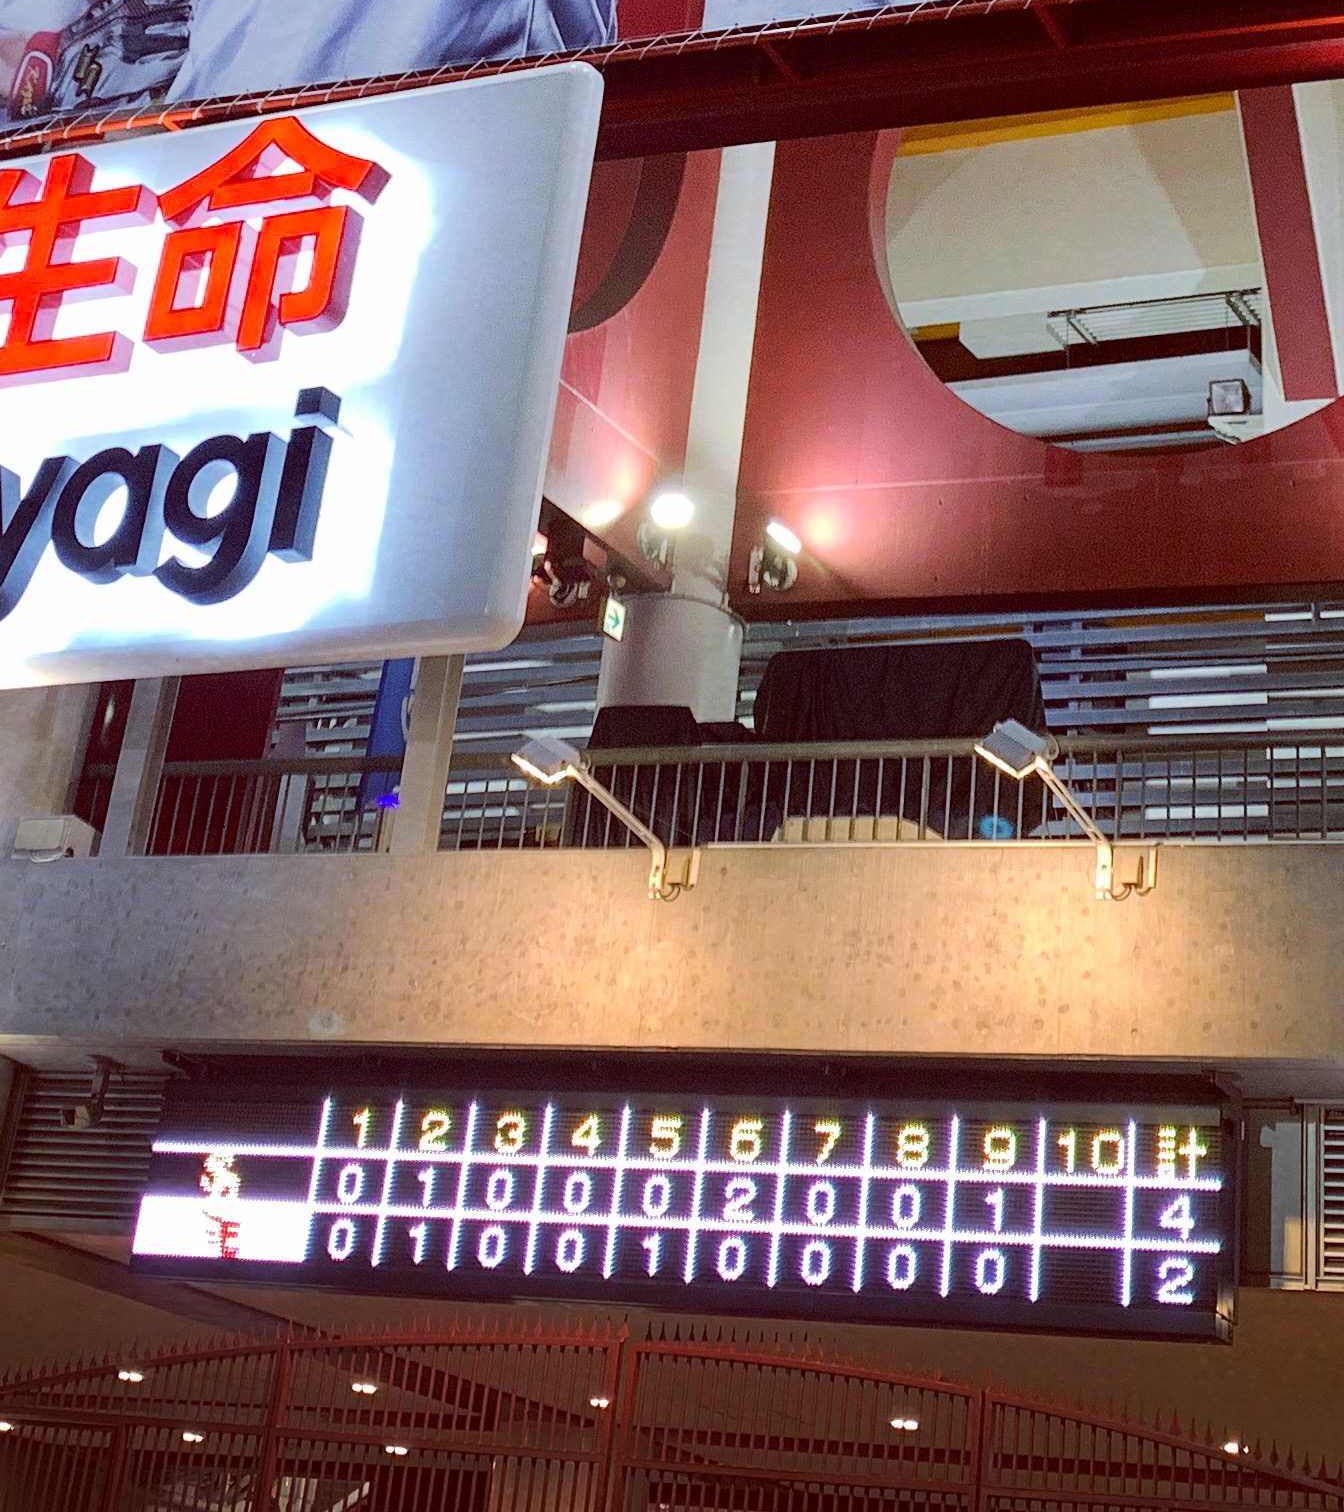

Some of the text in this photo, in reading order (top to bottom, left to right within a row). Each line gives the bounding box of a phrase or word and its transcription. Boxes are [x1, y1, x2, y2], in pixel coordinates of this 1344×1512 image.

[353, 1107, 372, 1149] 1
[419, 1108, 453, 1151] 2
[495, 1111, 529, 1153] 3
[571, 1112, 603, 1157] 4
[650, 1113, 682, 1159] 5
[730, 1118, 764, 1162] 6
[813, 1119, 843, 1164] 7
[896, 1122, 930, 1169] 8
[983, 1125, 1017, 1173] 9
[1058, 1127, 1126, 1175] 10
[337, 1163, 1195, 1240] 0 1 0 0 0 2 0 0 1 4
[327, 1219, 1192, 1304] 0 1 0 0 1 0 0 0 0 2
